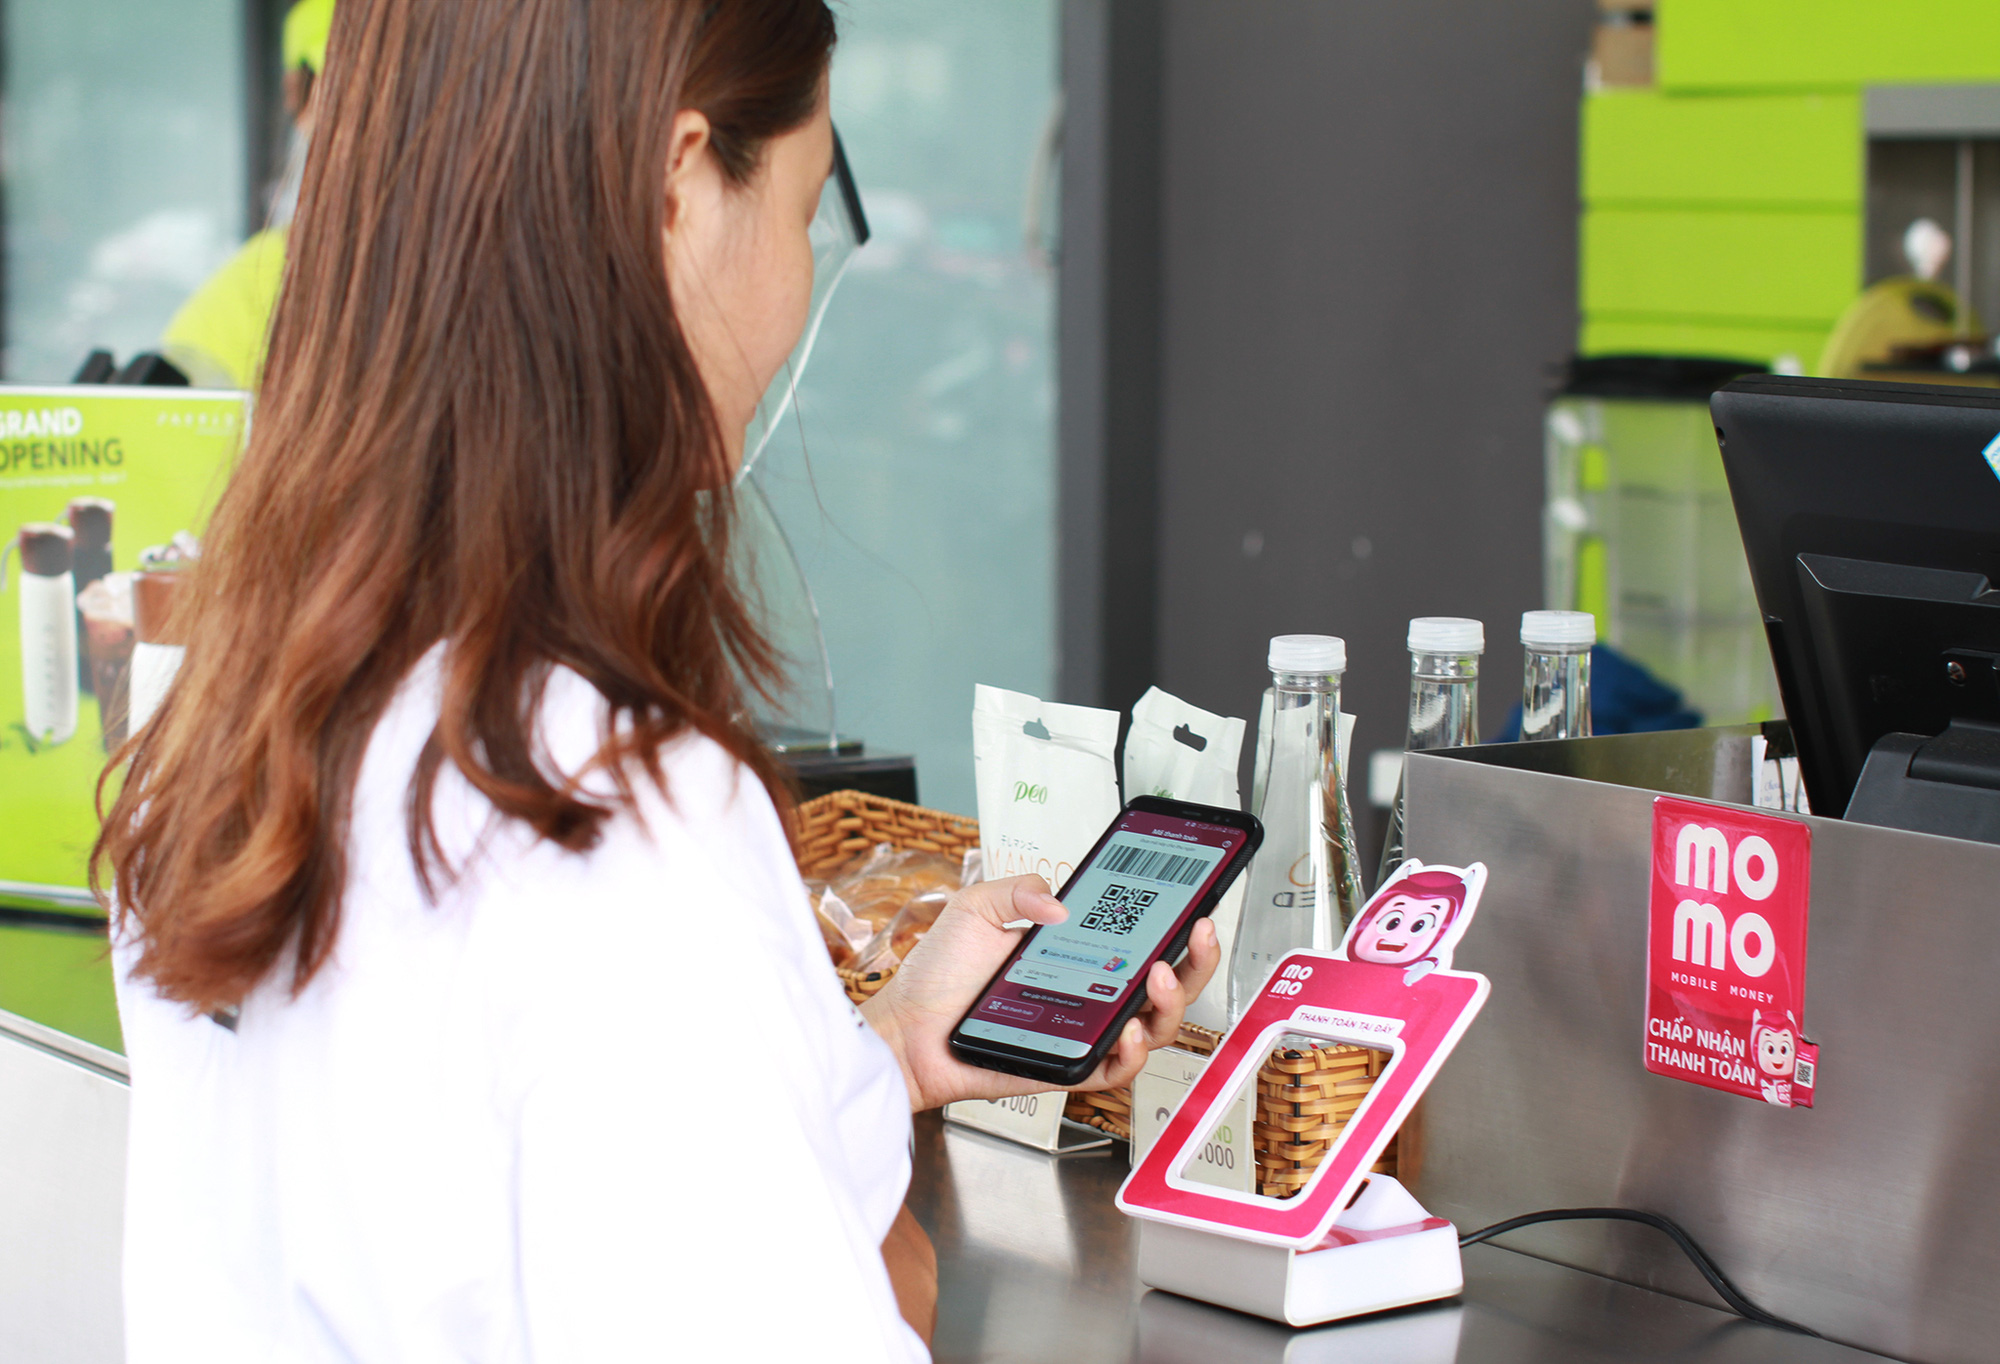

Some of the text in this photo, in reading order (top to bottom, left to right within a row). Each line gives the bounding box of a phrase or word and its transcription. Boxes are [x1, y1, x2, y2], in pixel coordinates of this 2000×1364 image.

[1671, 972, 1774, 1004] MOBILE MONEY
[1299, 1012, 1394, 1034] THANH TOÁN TẠI ĐÂY
[1649, 1016, 1745, 1058] CHẤP NHẬN
[1648, 1042, 1756, 1086] THANH TOÁN
[988, 1095, 1038, 1117] .000
[1213, 1124, 1233, 1144] ND
[1198, 1142, 1234, 1170] .000
